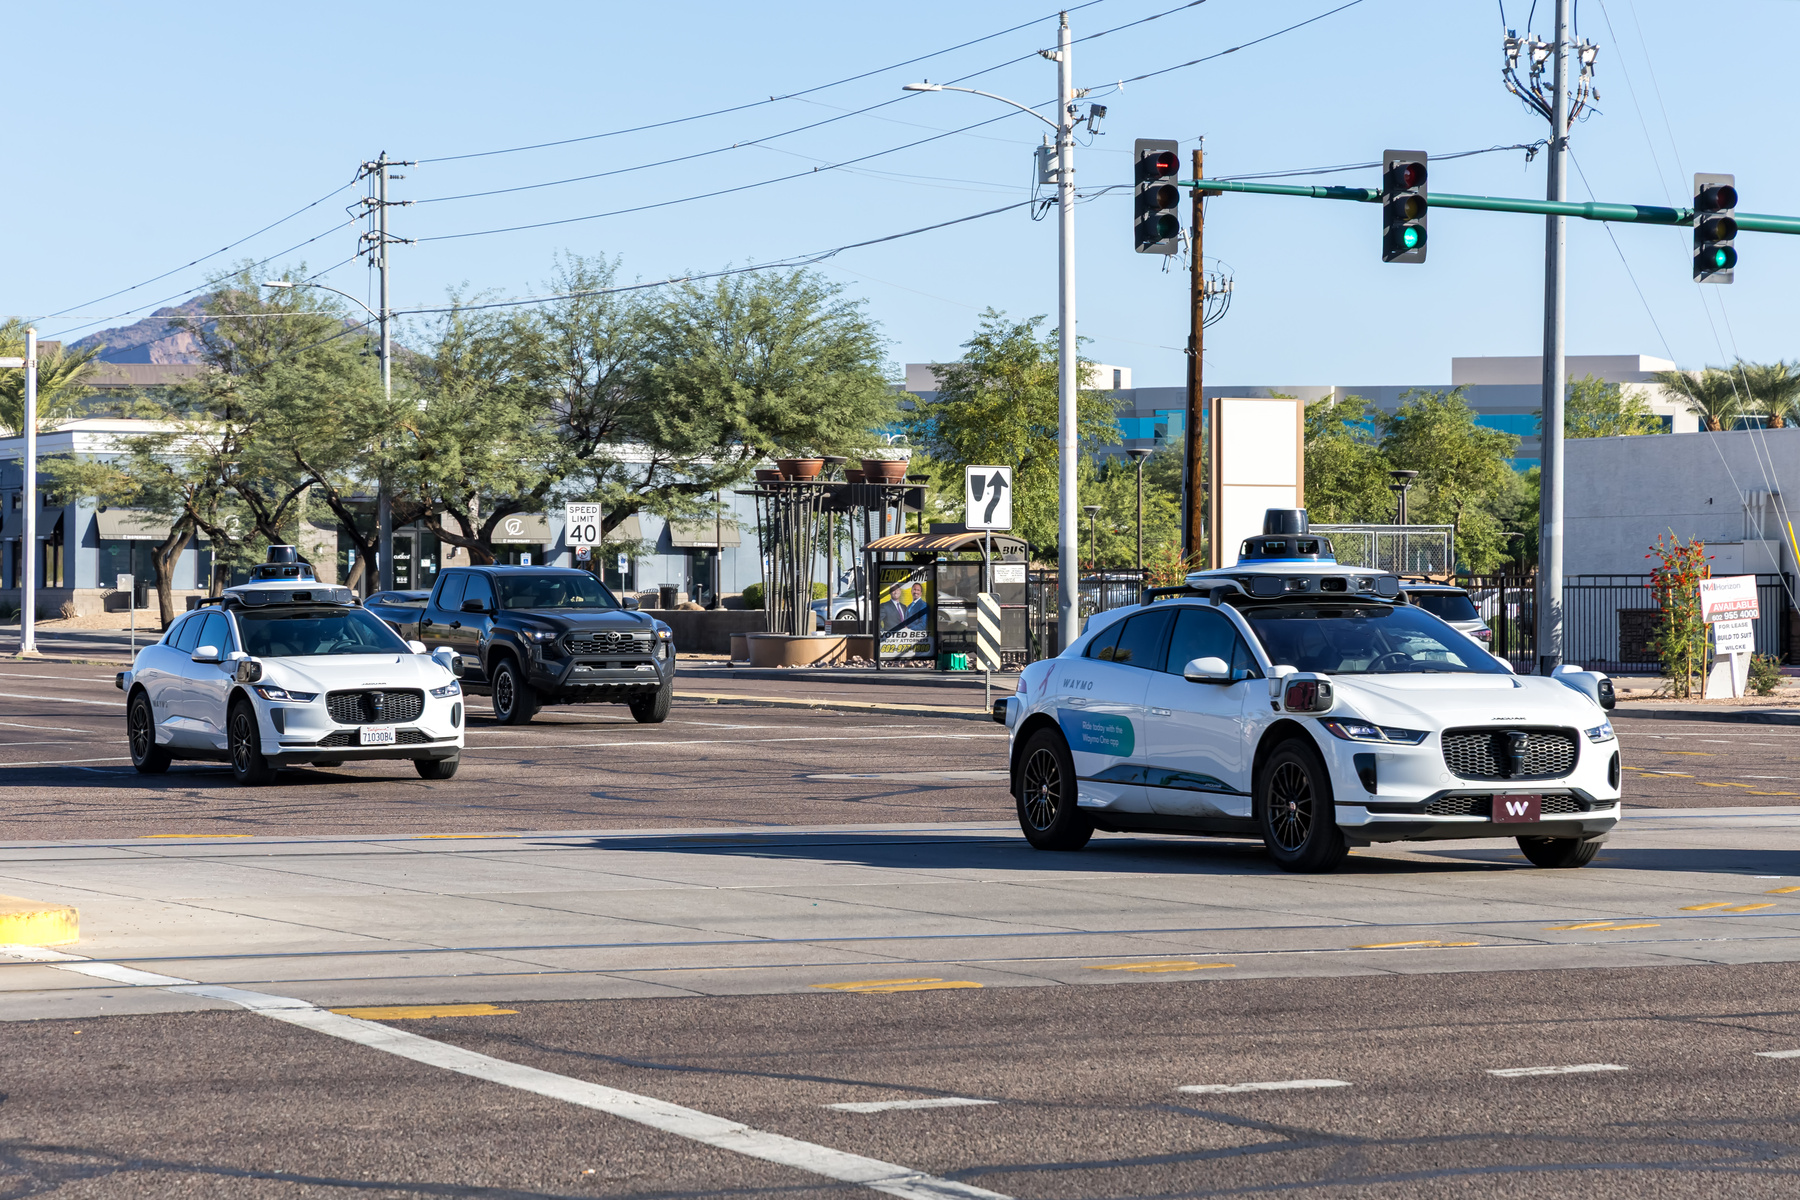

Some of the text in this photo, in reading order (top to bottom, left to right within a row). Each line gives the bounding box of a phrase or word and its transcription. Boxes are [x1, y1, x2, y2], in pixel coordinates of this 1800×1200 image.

[569, 506, 597, 514] SPEED
[571, 515, 594, 523] LIMIT
[570, 524, 596, 542] 40
[1002, 546, 1025, 555] BUS
[880, 568, 909, 582] LERNER
[1702, 582, 1741, 592] NAI Horizon
[1713, 600, 1757, 612] AVAILABLE
[1724, 611, 1738, 620] 955
[1740, 609, 1758, 618] 4000
[880, 631, 907, 639] VOTED
[1063, 679, 1093, 690] WAYMO
[1082, 720, 1092, 730] Ride
[1093, 724, 1105, 734] today
[1082, 734, 1119, 747] Waymo One app
